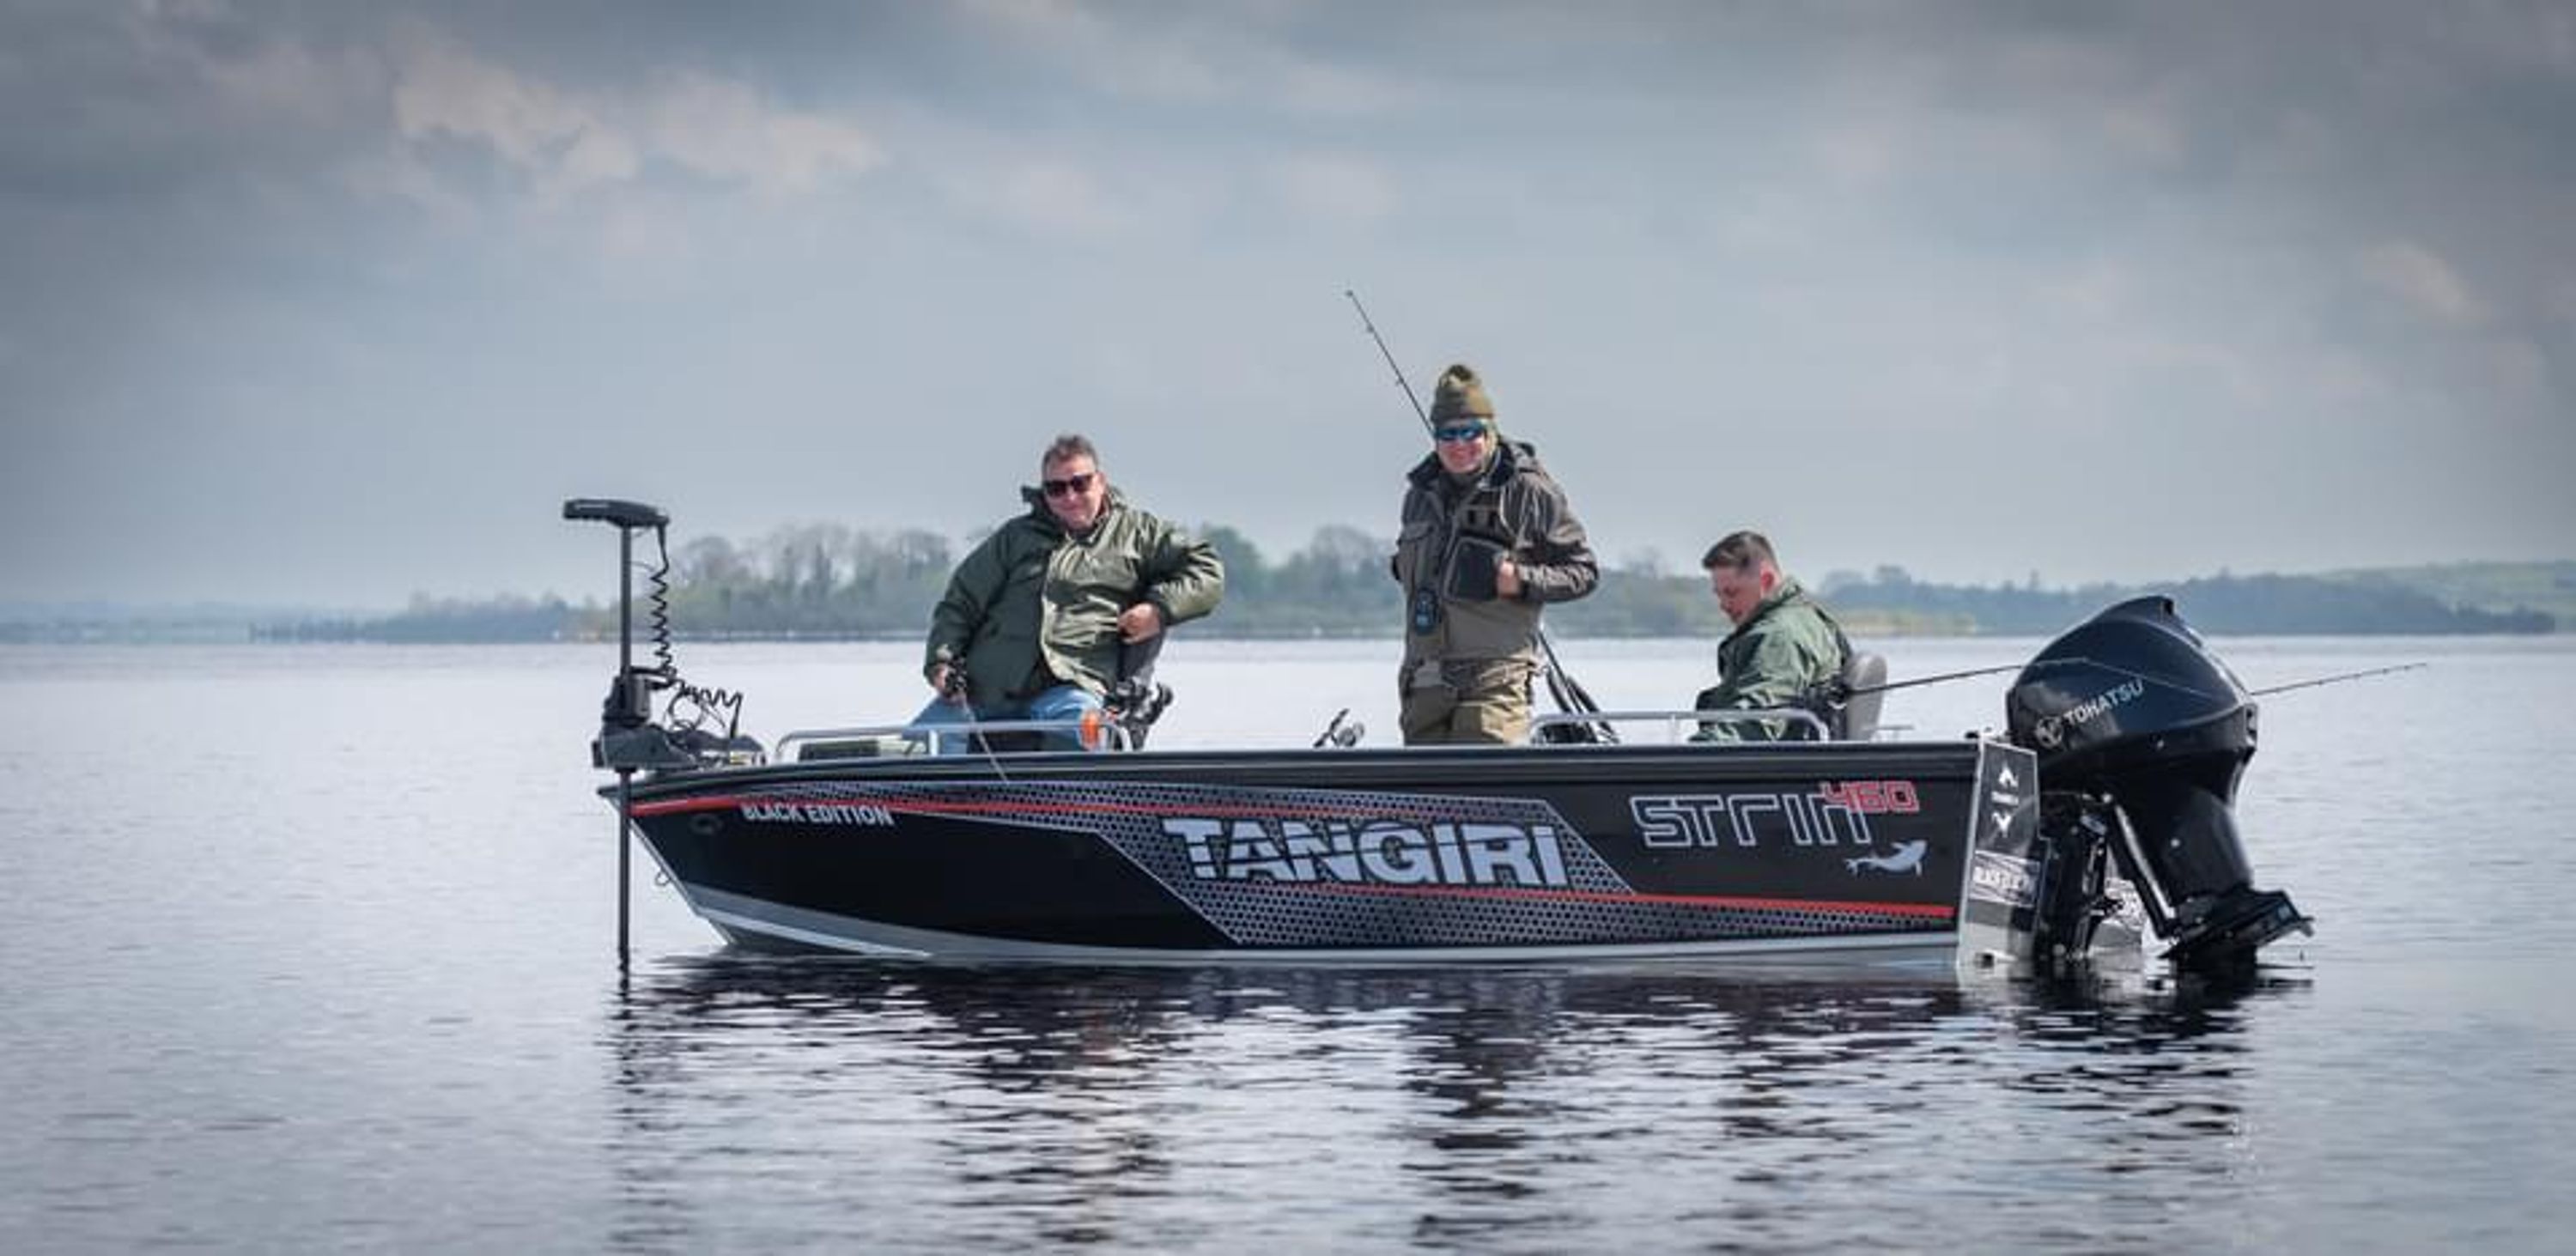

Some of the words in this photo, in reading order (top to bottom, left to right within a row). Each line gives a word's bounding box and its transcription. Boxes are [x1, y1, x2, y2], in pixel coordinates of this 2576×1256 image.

[2063, 678, 2144, 726] TOHATSU
[740, 802, 806, 822] BLACK
[805, 804, 895, 827] EDITION
[1820, 780, 1920, 813] 460
[1163, 818, 1569, 886] TANGIRI
